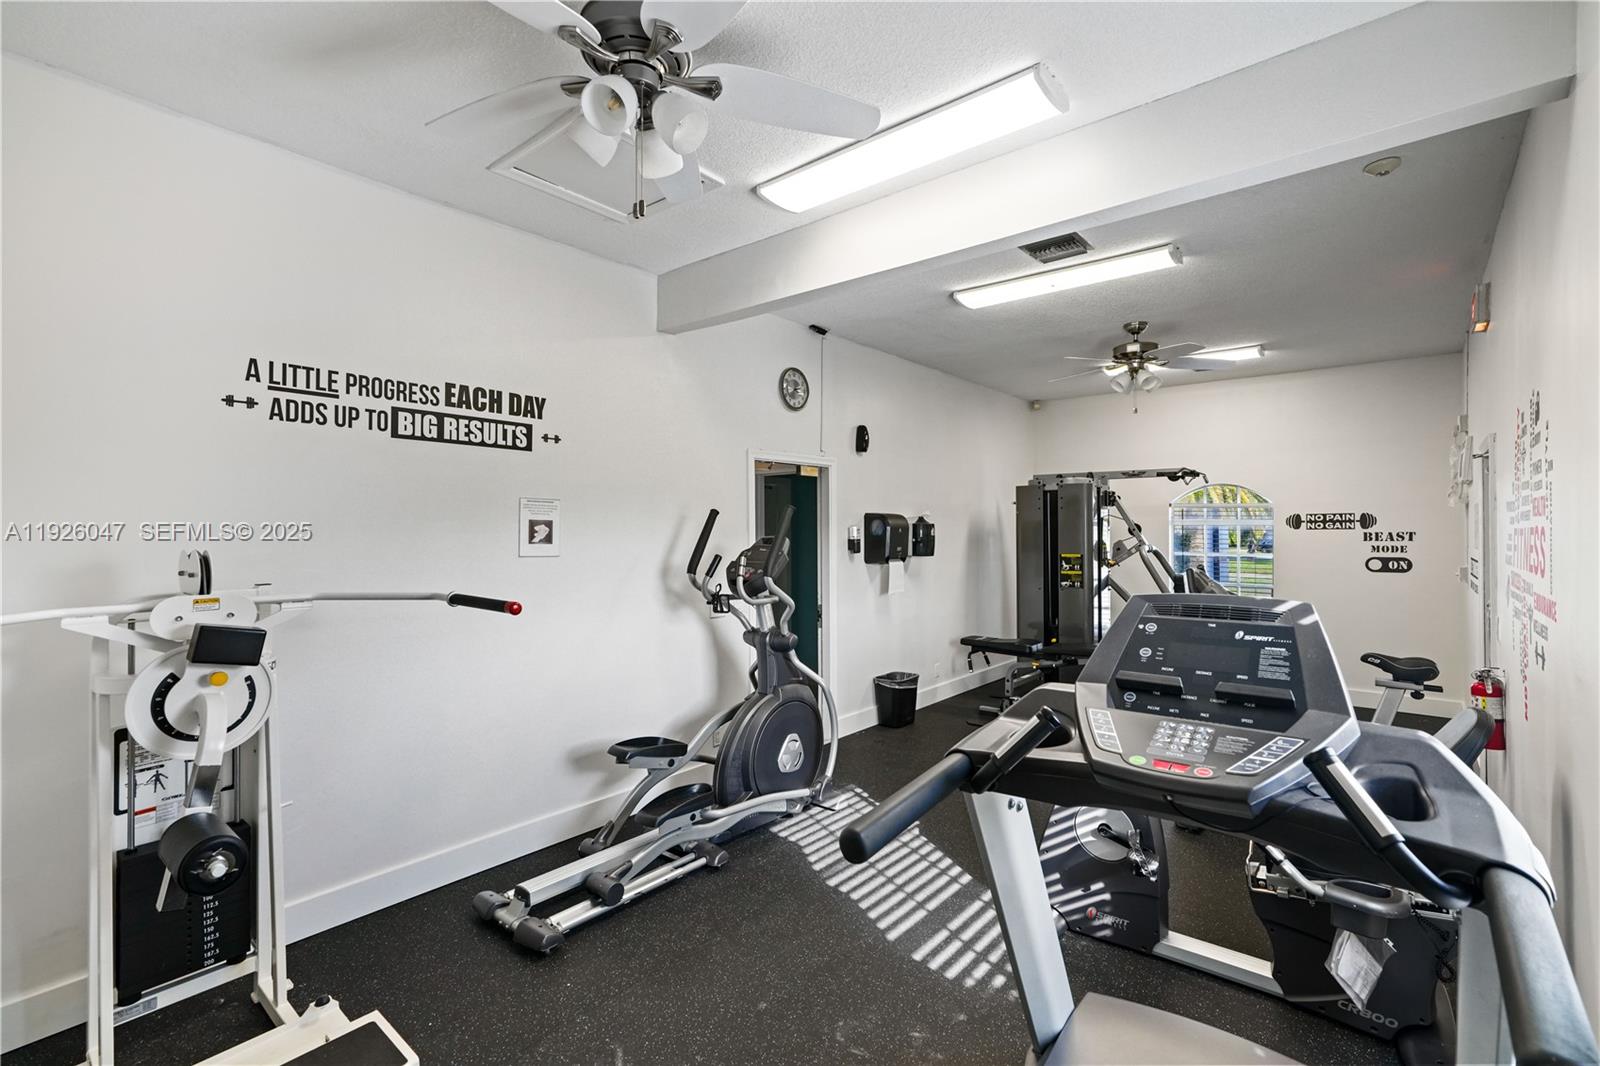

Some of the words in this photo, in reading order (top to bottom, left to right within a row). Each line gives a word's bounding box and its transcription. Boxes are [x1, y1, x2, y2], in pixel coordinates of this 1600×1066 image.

[245, 358, 261, 383] A
[268, 360, 339, 394] LITTLE
[345, 373, 440, 406] PROGRESS
[444, 382, 503, 412] EACH
[508, 392, 547, 420] DAY
[269, 397, 328, 426] ADDS
[334, 405, 360, 429] UP
[365, 409, 389, 432] TO
[397, 411, 438, 438] BIG
[443, 418, 528, 448] RESULTS
[1306, 513, 1323, 521] NO
[1326, 513, 1355, 521] PAIN
[1306, 522, 1323, 530] NO
[1325, 521, 1355, 530] GAIN
[1363, 531, 1417, 542] BEAST
[1371, 545, 1408, 553] MODE
[1512, 525, 1546, 579] FITNESS
[1388, 560, 1408, 570] ON
[1243, 634, 1275, 642] SPIRIT
[203, 900, 219, 910] 112.5
[203, 910, 213, 918] 125
[203, 925, 214, 933] 150
[204, 942, 214, 950] 175
[204, 958, 215, 967] 200
